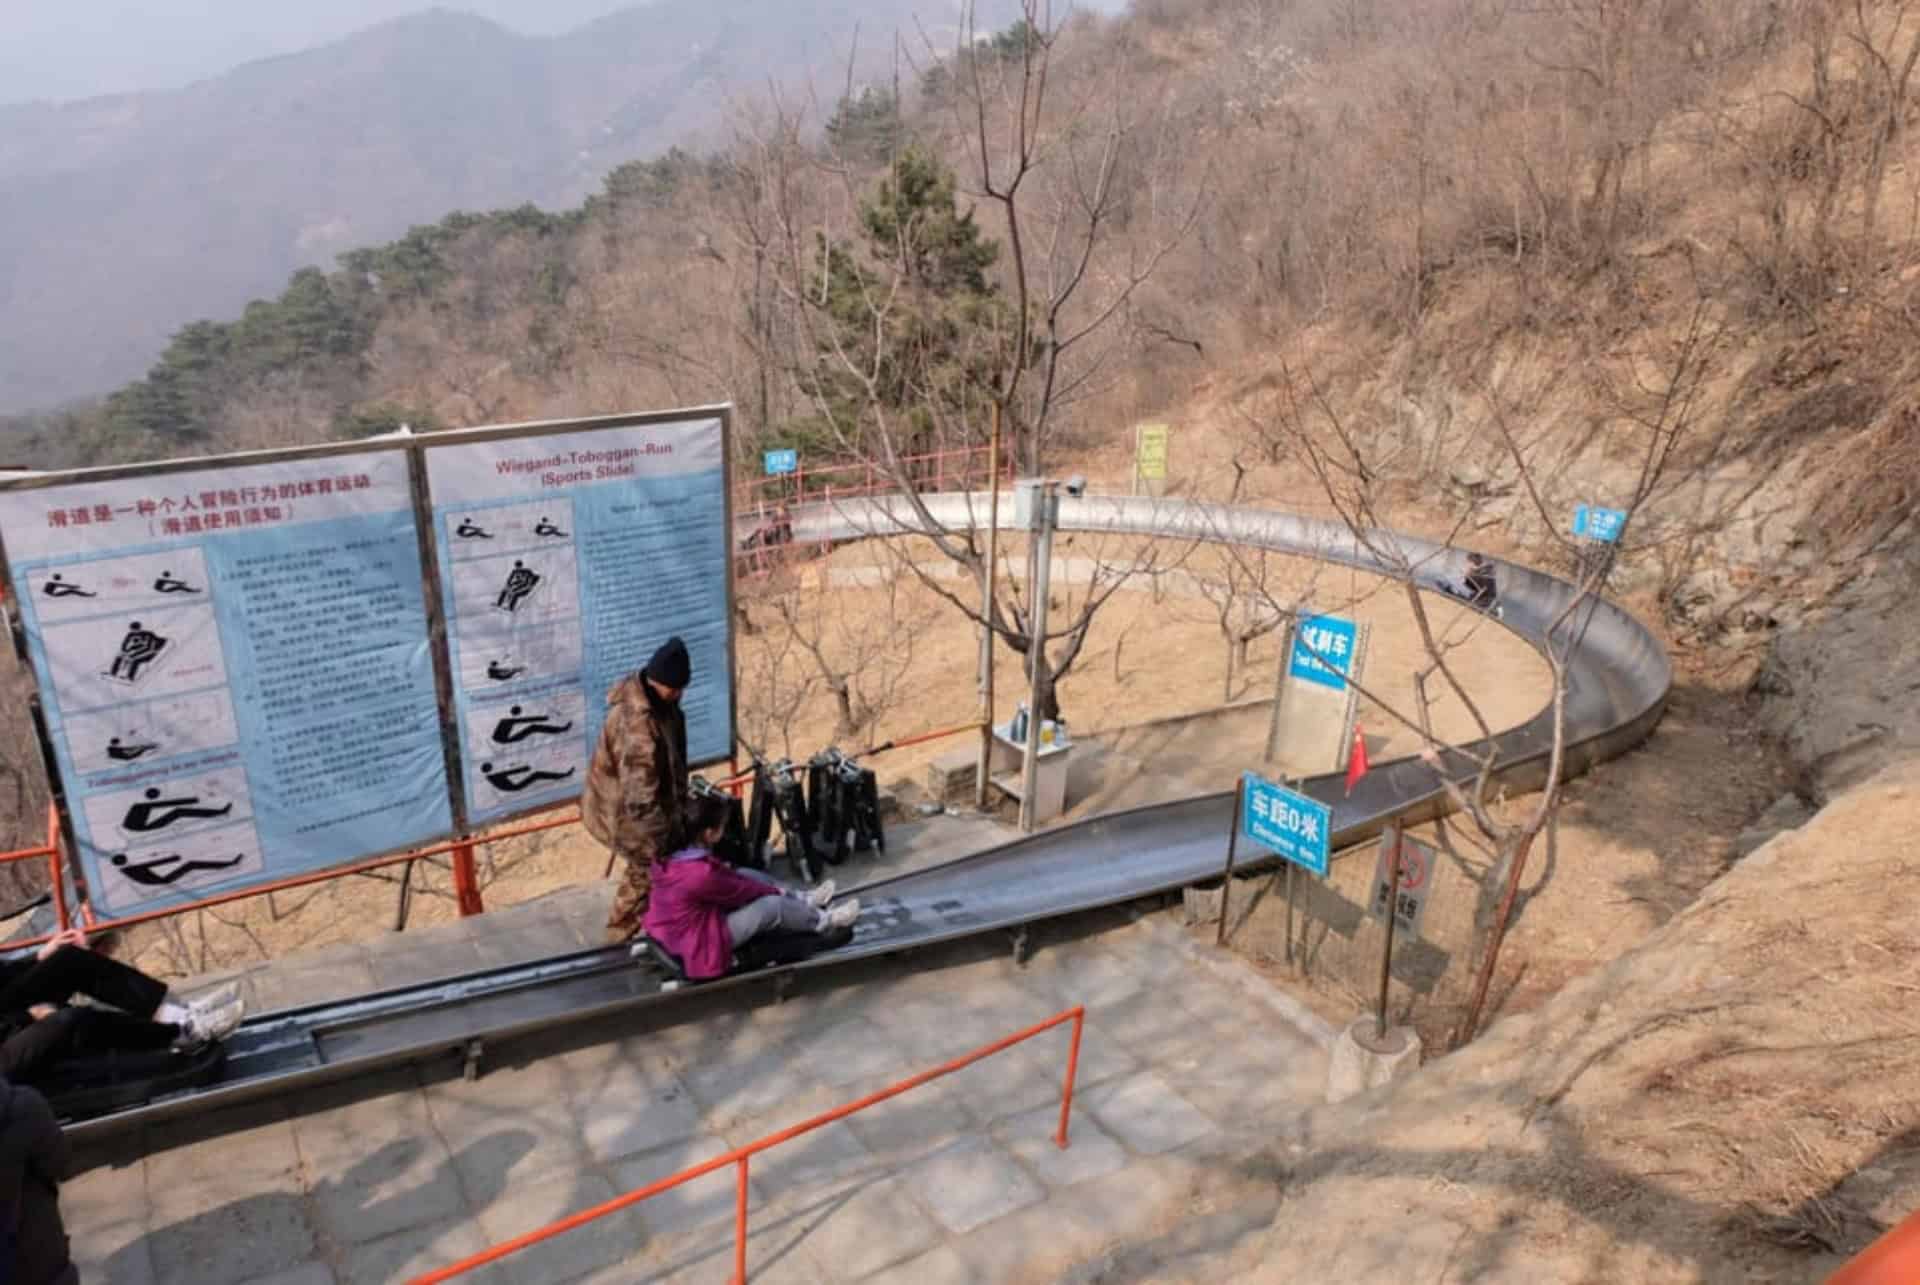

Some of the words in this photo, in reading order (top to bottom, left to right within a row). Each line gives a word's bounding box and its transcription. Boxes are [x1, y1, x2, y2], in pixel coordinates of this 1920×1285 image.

[47, 474, 371, 527] 滑道是一种个人冒险行为的体育运动
[1252, 790, 1319, 843] 车距0米
